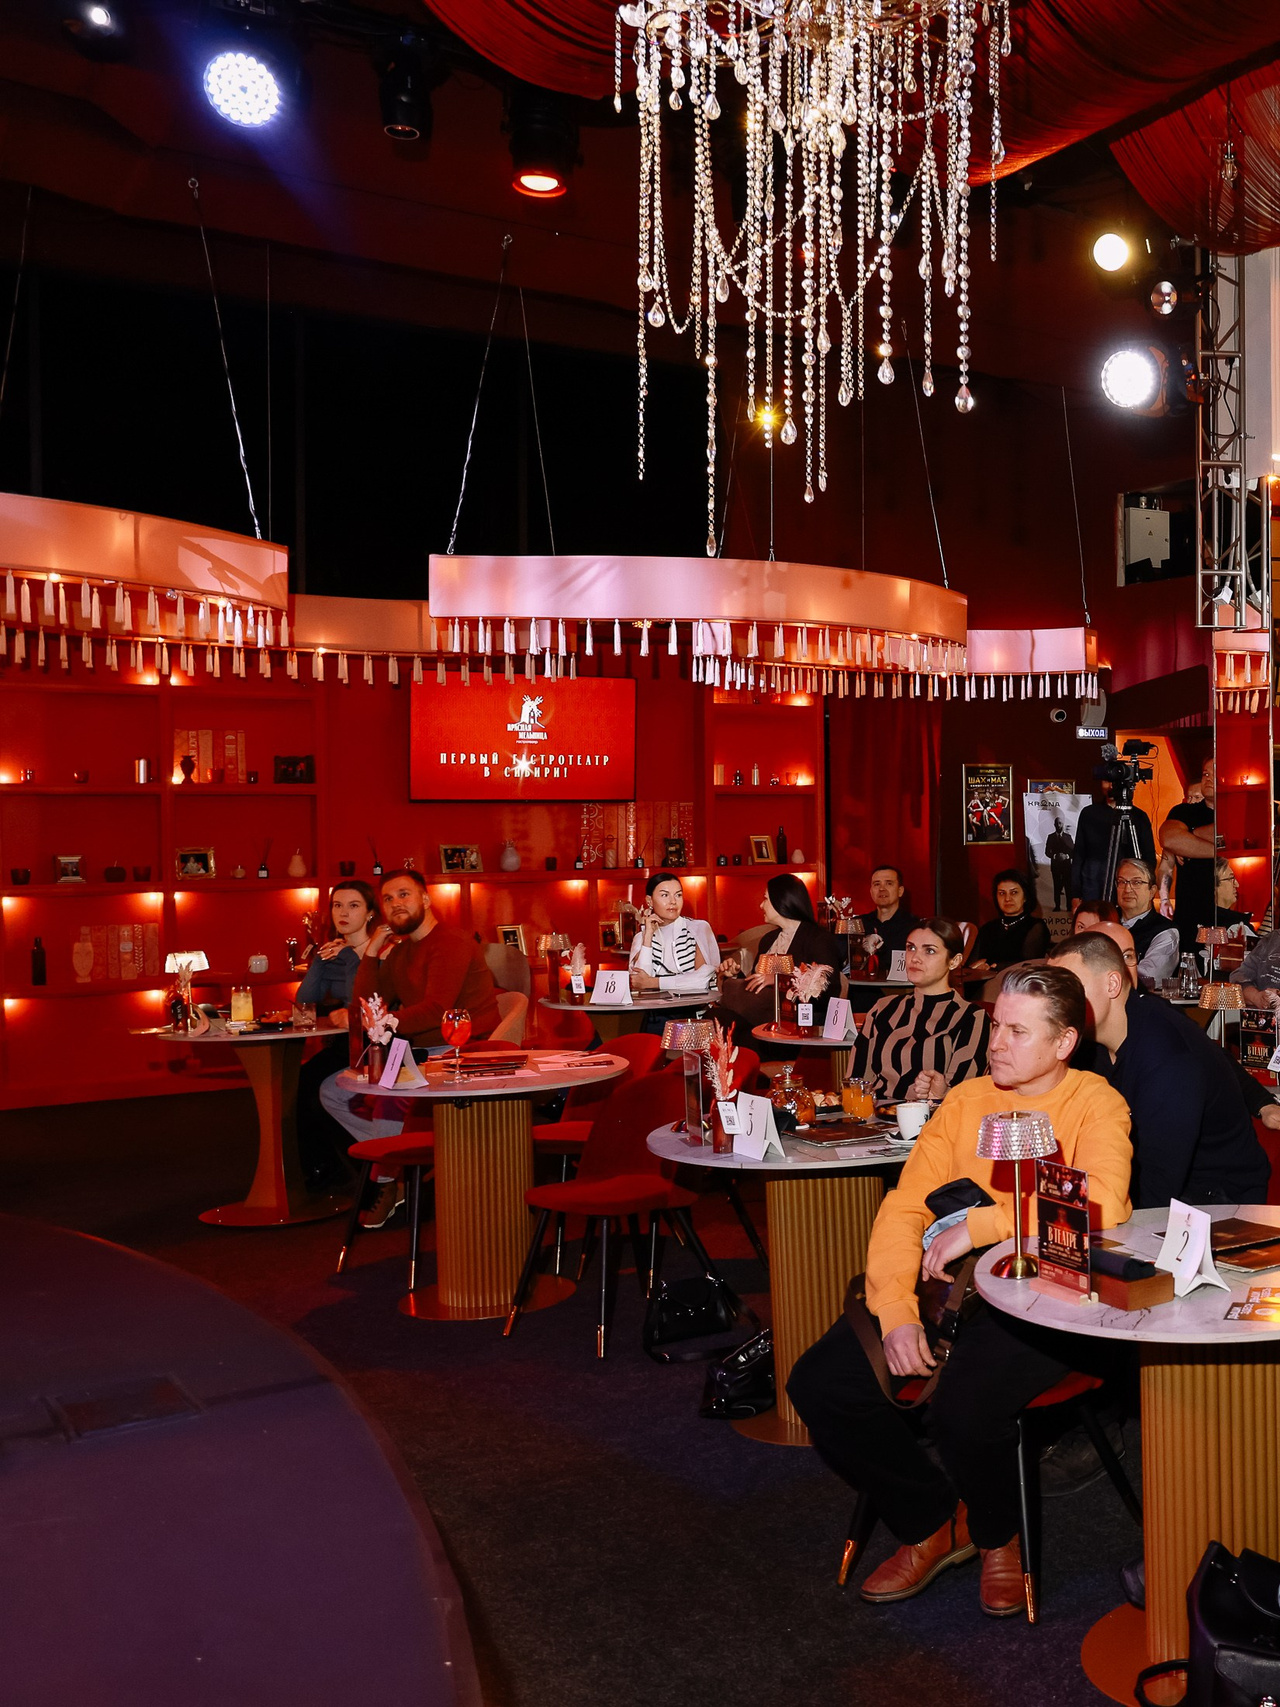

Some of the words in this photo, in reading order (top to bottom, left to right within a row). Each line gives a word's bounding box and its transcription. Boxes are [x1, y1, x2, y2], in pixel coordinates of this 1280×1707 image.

[440, 752, 499, 765] ПЕРВЫЙ
[483, 766, 491, 778] В
[968, 776, 986, 784] ШАХ
[991, 776, 1007, 784] МАТ
[897, 959, 906, 971] 20
[604, 980, 616, 993] 18
[832, 1009, 839, 1026] 8
[1053, 1227, 1078, 1250] ТЕАТРЕ
[1176, 1230, 1190, 1262] 2
